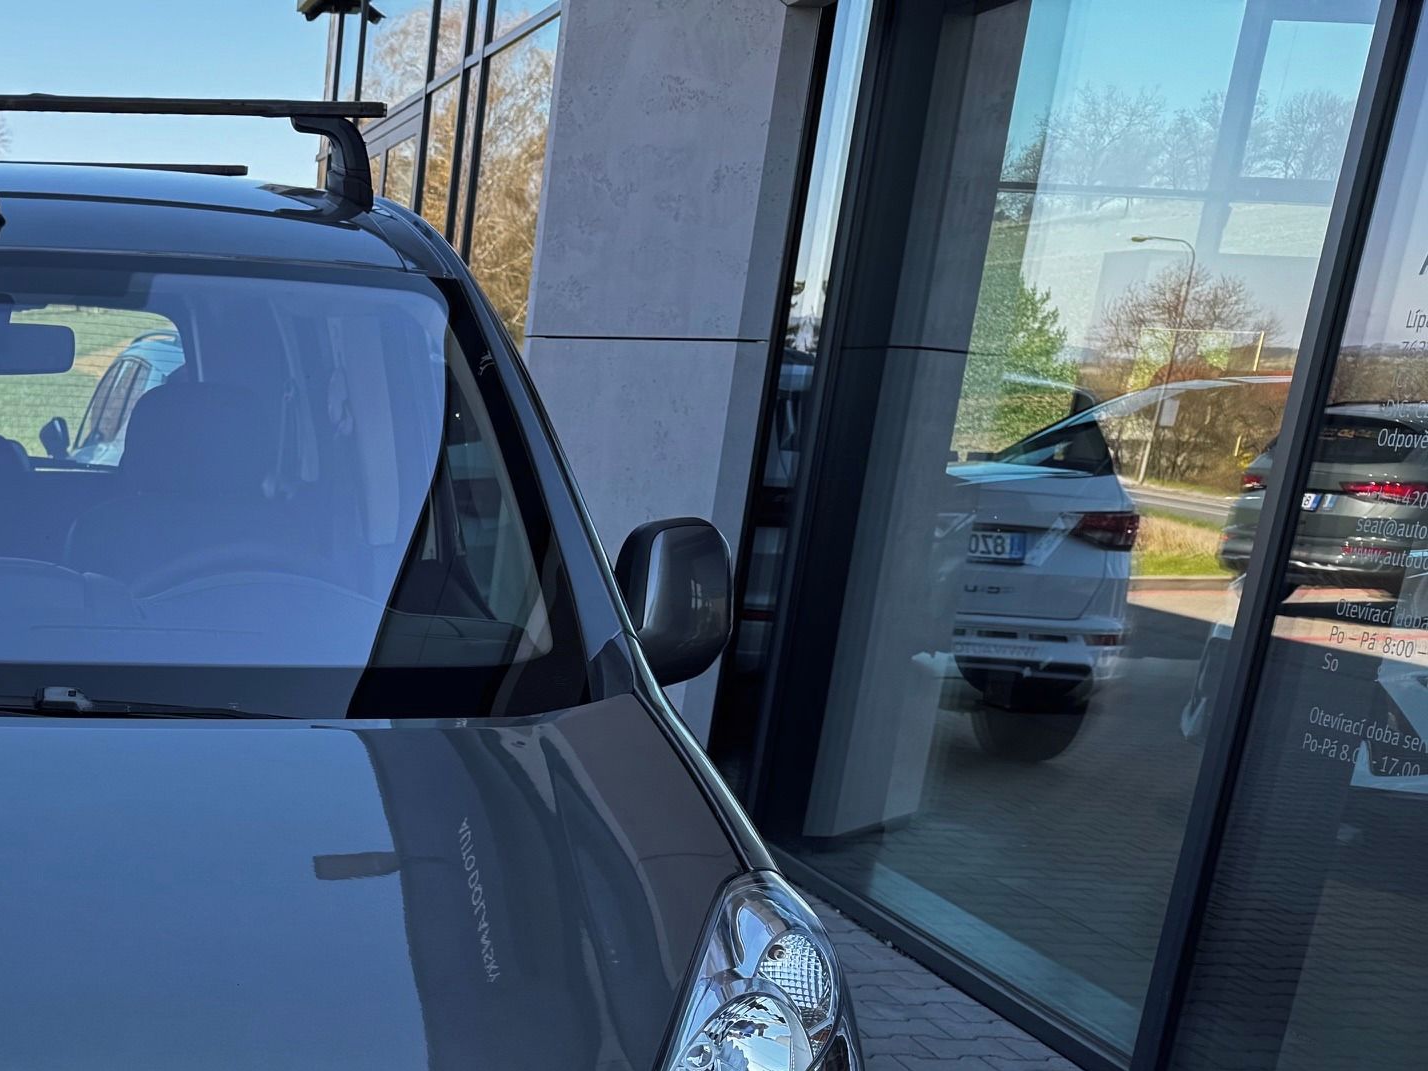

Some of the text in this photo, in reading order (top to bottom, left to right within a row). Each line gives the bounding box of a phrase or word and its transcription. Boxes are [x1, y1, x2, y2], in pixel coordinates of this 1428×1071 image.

[1336, 598, 1395, 624] Otevírací
[1329, 625, 1345, 643] Po
[1360, 631, 1377, 650] Pá
[1382, 636, 1415, 658] 8:00
[1322, 652, 1339, 672] So
[1309, 706, 1366, 736] Otevírací
[1367, 721, 1400, 746] doba
[1302, 732, 1338, 758] Po-Pá
